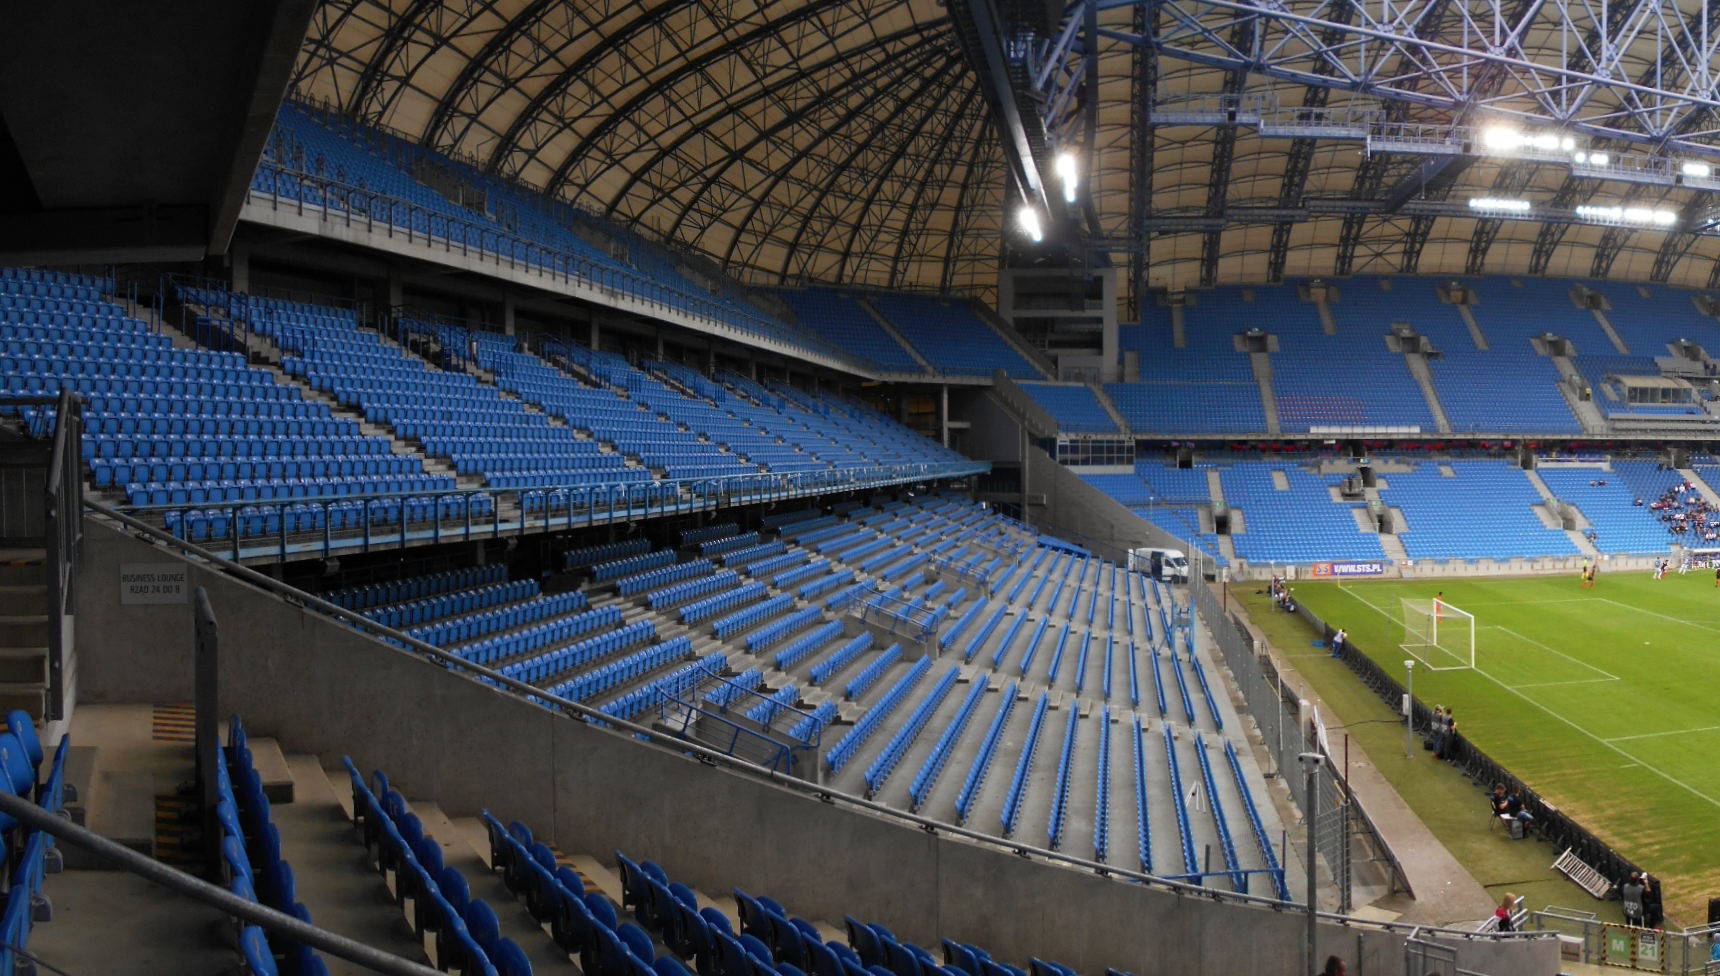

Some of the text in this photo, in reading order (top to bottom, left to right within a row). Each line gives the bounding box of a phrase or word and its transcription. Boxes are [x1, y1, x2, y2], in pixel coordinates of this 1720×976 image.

[1333, 563, 1382, 573] WWW.STS.PL
[122, 573, 185, 583] BUSINESS LOUNGE
[1611, 938, 1625, 952] M
[1640, 943, 1656, 957] 21
